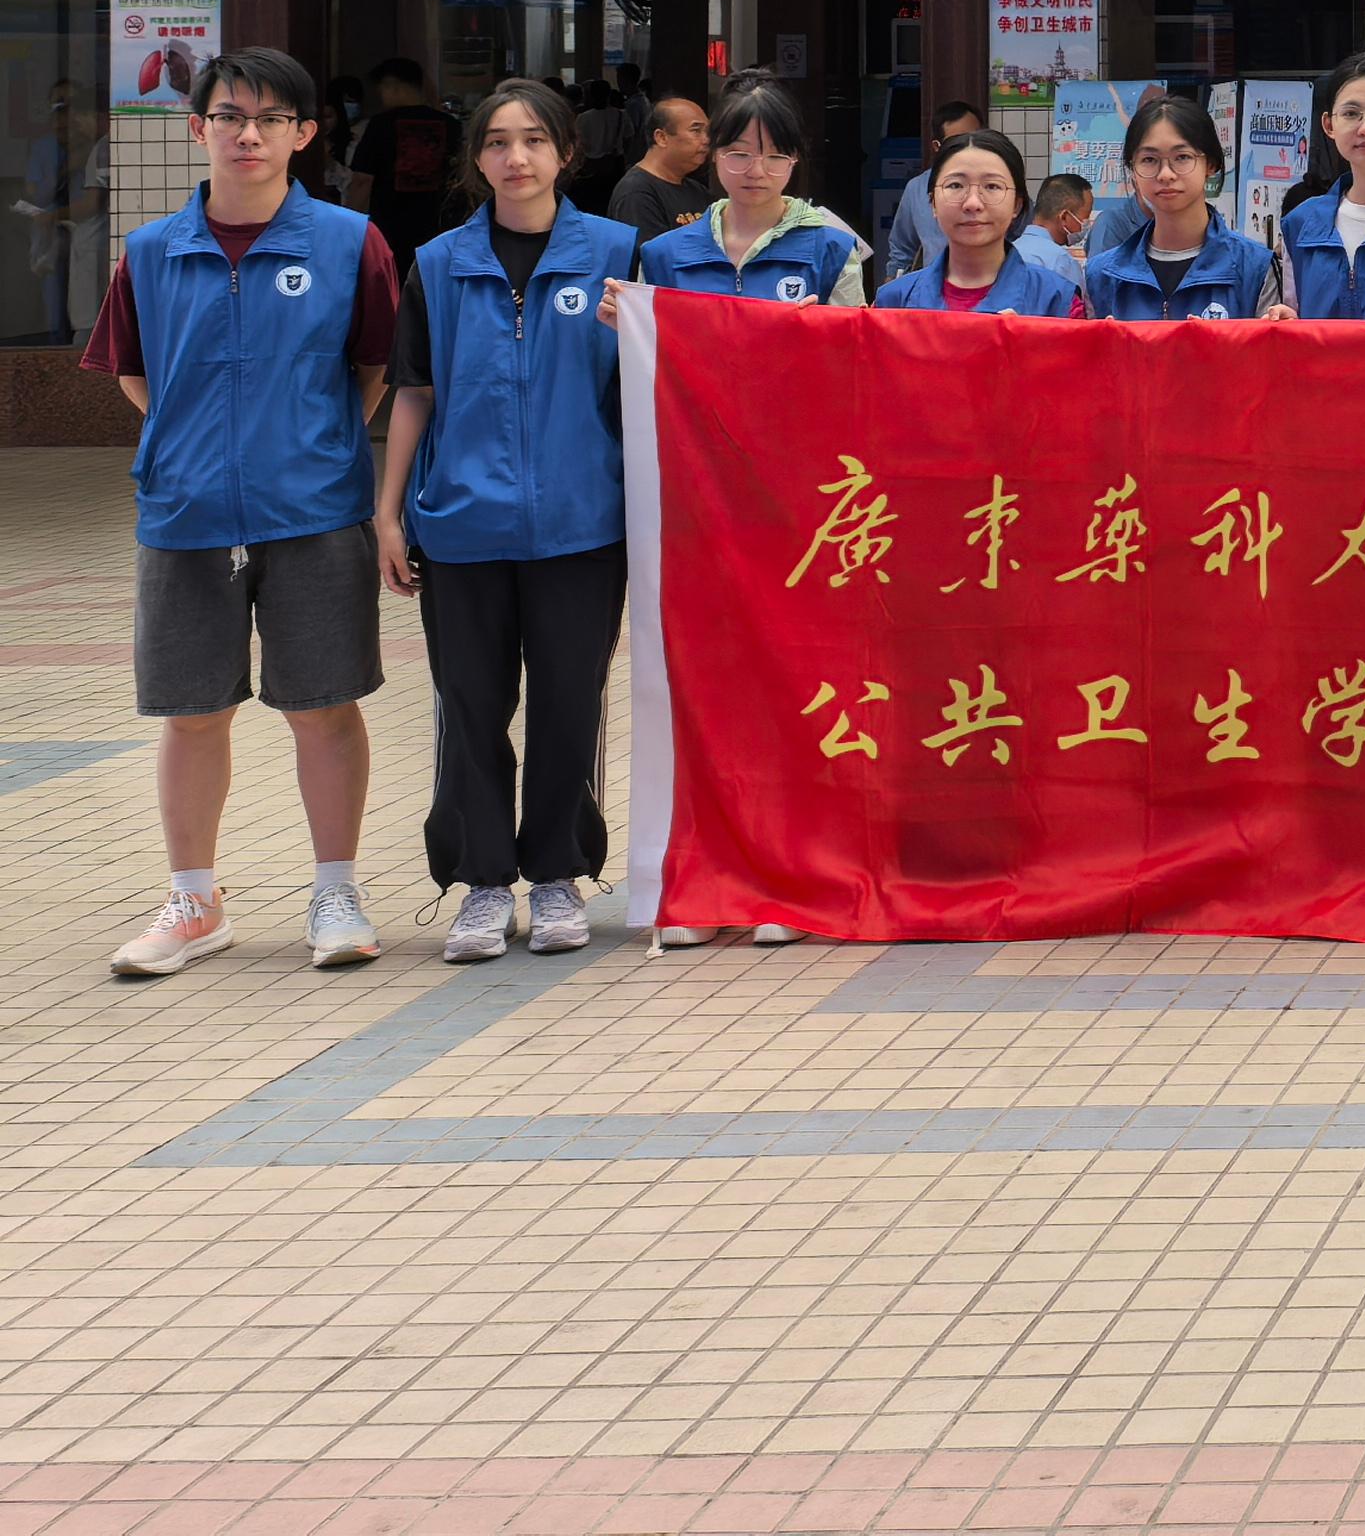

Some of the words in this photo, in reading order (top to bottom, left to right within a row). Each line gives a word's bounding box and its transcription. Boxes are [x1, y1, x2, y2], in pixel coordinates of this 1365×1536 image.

[997, 15, 1094, 34] 争创卫生城市
[1075, 140, 1126, 161] 夏季高
